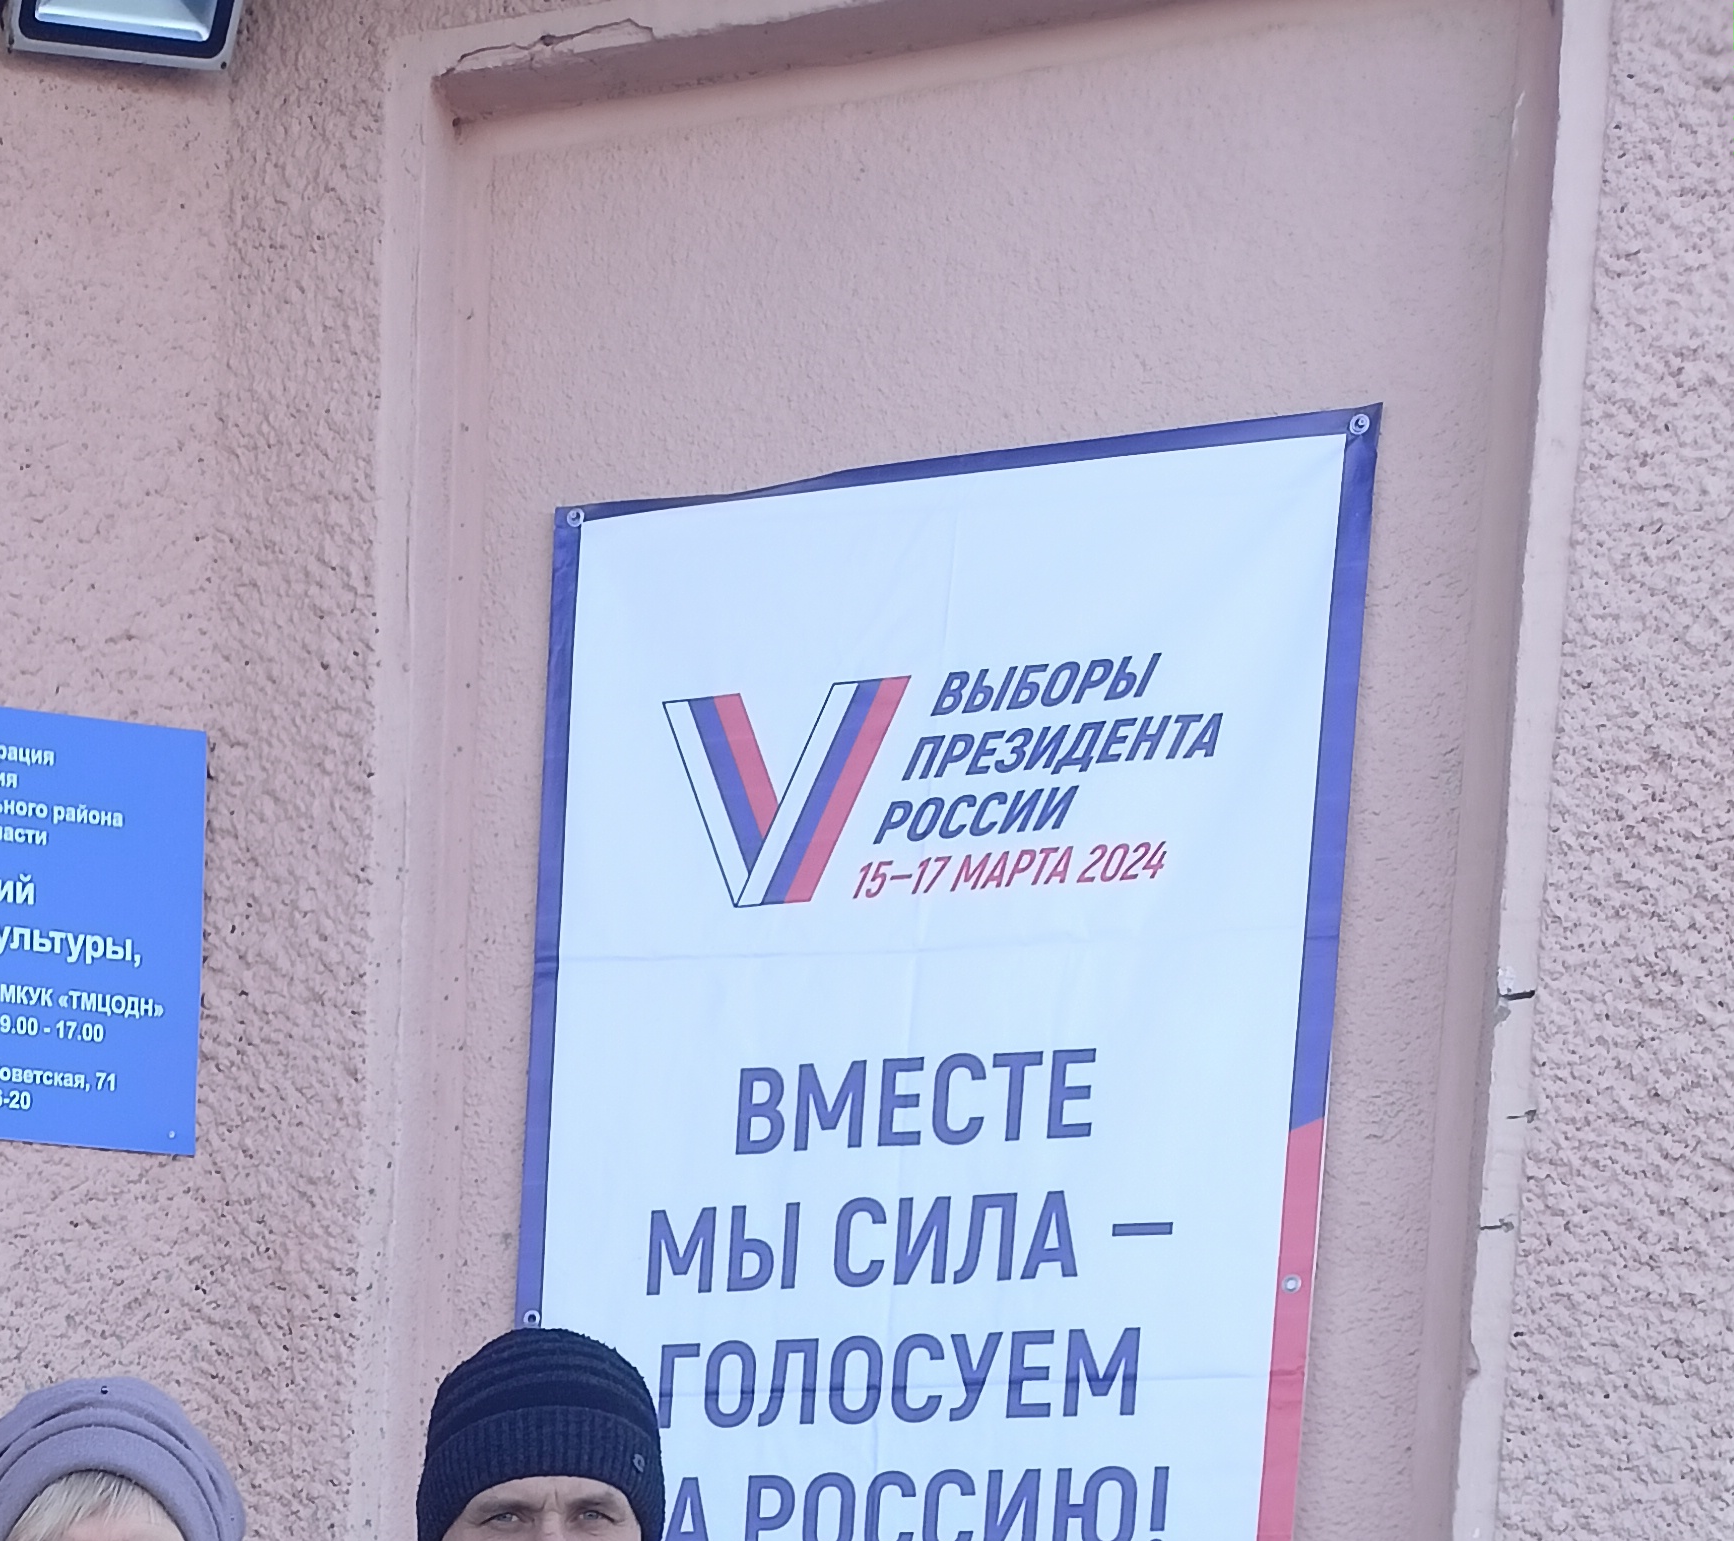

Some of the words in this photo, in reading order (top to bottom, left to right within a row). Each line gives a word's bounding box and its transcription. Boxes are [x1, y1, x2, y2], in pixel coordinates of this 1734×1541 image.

[930, 652, 1162, 716] ВЫБОРЫ
[901, 712, 1224, 781] ПРЕЗИДЕНТА
[51, 804, 124, 829] района
[872, 784, 1080, 845] РОССИИ
[949, 845, 1074, 893] МАРТА
[1075, 840, 1167, 884] 2024
[0, 983, 54, 1008] МКУК
[58, 993, 165, 1019] «ТМЦОДН»
[0, 1014, 39, 1036] 9.00
[55, 1020, 105, 1043] 17.00
[95, 1070, 118, 1093] 71
[734, 1048, 1097, 1156] ВМЕСТЕ
[646, 1202, 801, 1296] МЫ
[832, 1190, 1079, 1288] СИЛА
[657, 1327, 1141, 1430] ГОЛОСУЕМ
